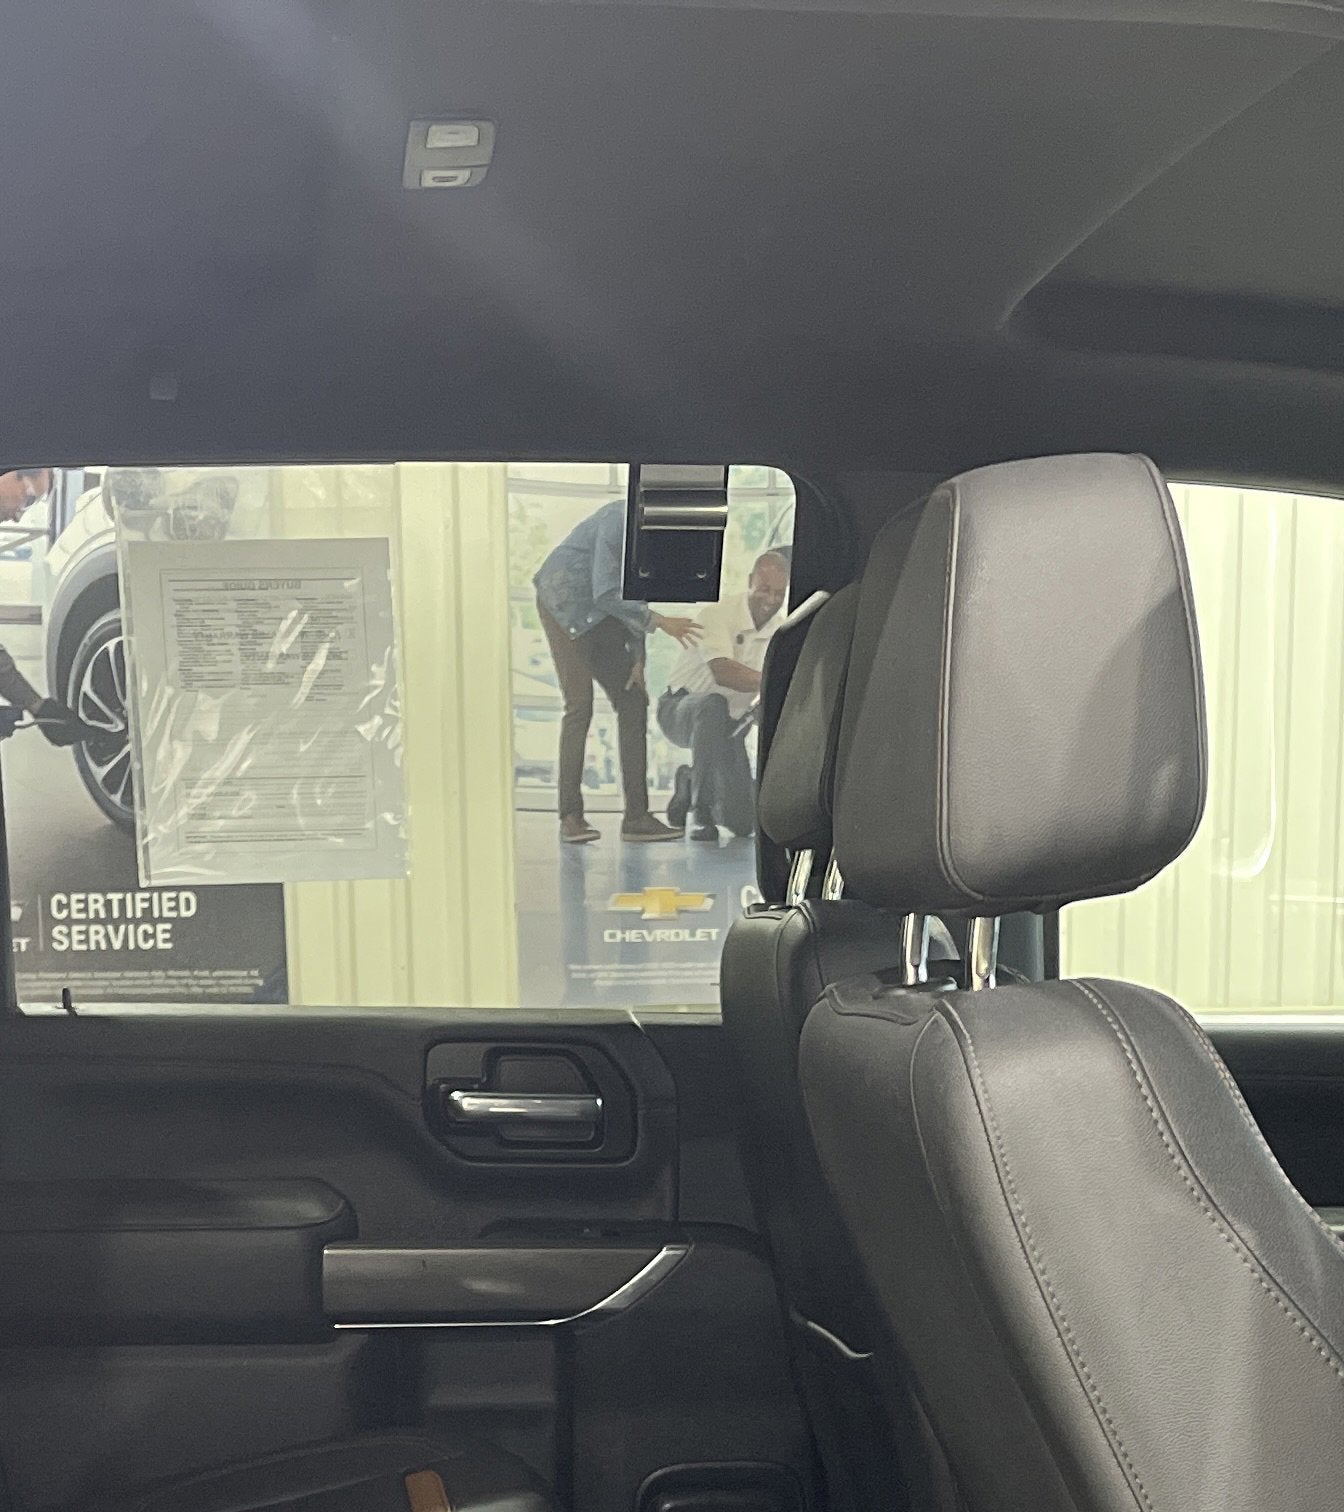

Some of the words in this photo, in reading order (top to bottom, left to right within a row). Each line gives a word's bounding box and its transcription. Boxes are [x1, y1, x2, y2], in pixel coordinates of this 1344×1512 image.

[50, 890, 198, 920] CERTIFIED
[51, 922, 174, 951] SERVICE
[603, 928, 721, 943] CHEVROLET
